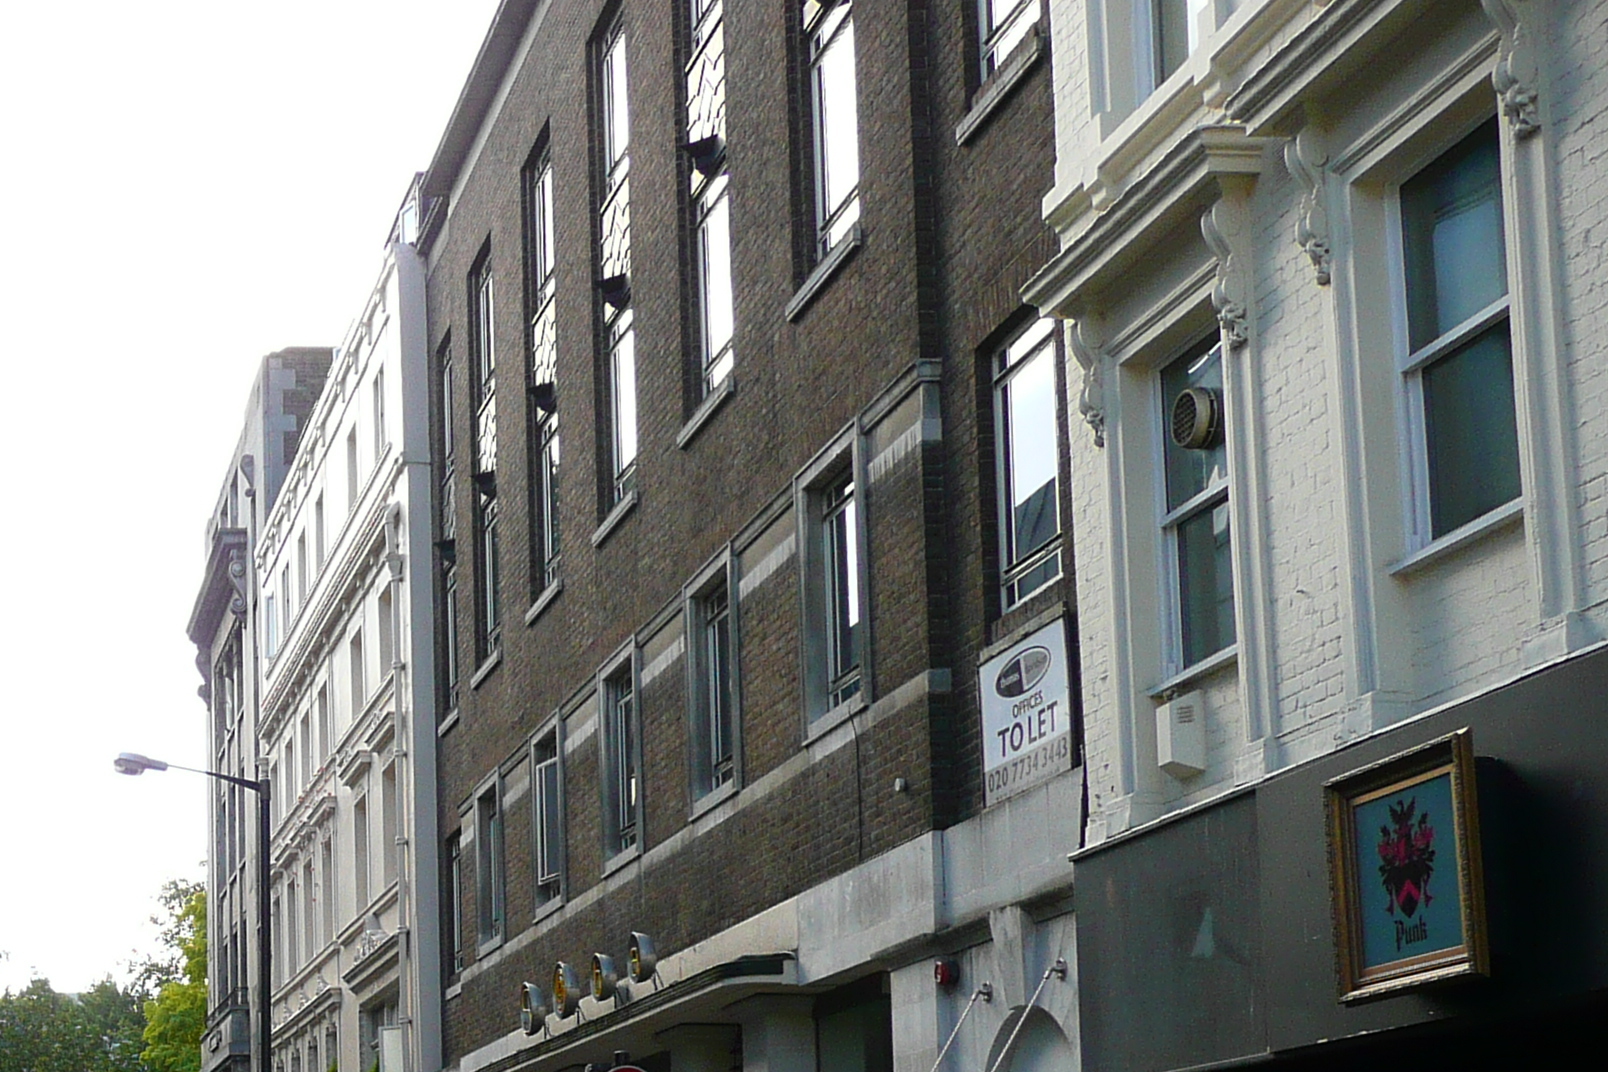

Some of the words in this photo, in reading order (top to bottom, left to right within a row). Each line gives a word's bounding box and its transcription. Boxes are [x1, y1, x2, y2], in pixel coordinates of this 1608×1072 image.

[1012, 689, 1044, 718] OFFICES
[997, 721, 1024, 757] TO
[1027, 700, 1058, 745] LET
[988, 766, 1009, 793] 020
[1012, 750, 1039, 783] 7734
[1041, 736, 1068, 768] 3443
[1393, 914, 1428, 952] Punk
